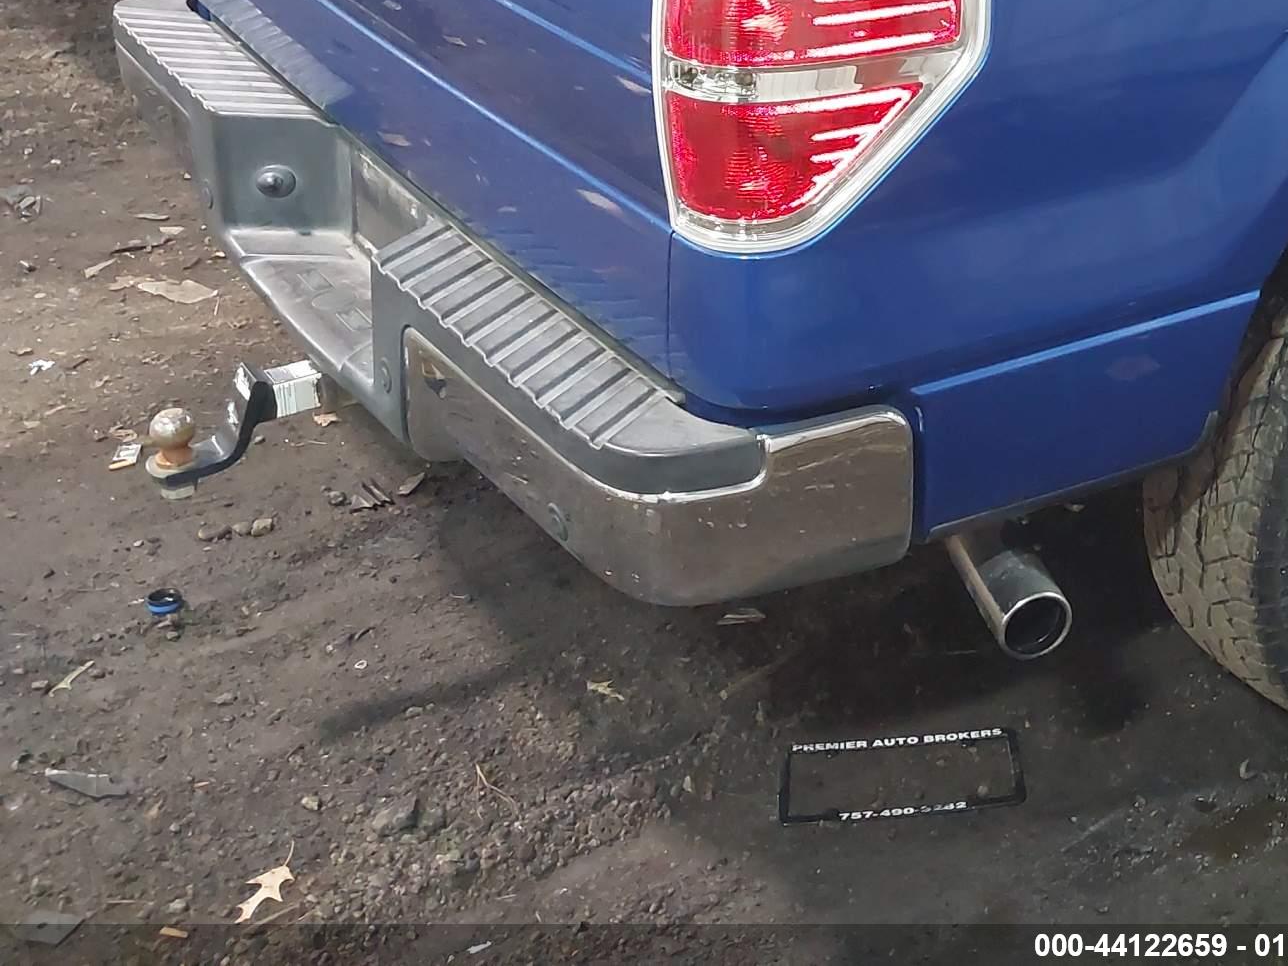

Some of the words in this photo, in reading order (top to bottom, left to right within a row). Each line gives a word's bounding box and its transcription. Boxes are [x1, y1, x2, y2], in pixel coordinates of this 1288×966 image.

[791, 740, 868, 753] PREMIER
[872, 736, 919, 748] AUTO
[923, 727, 1003, 744] BROKERS
